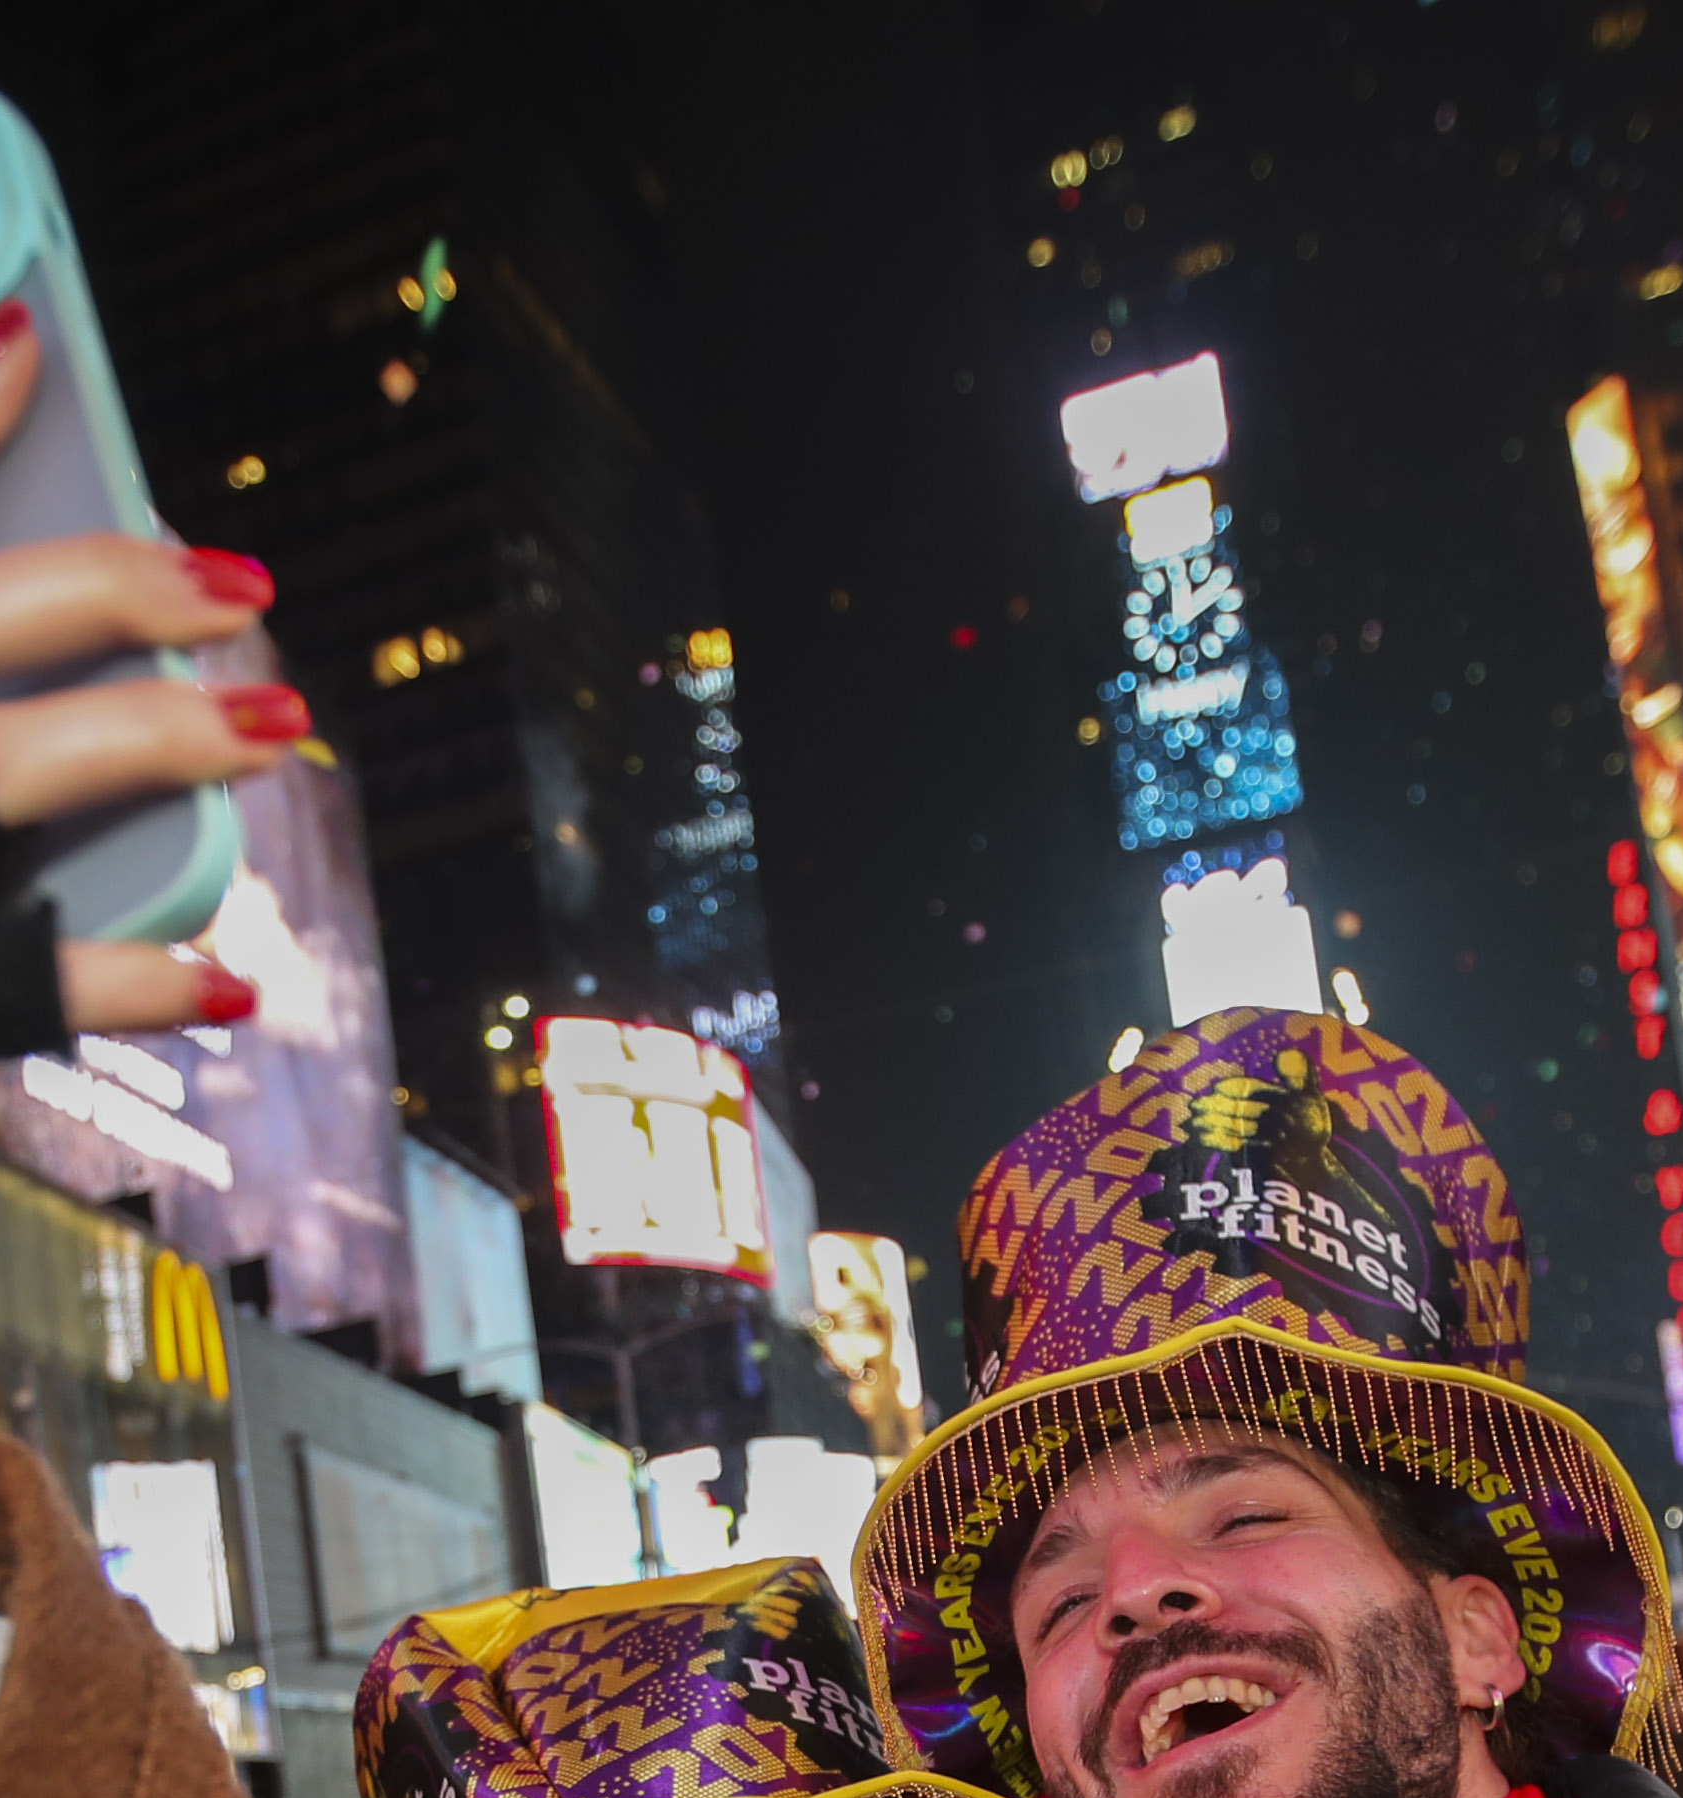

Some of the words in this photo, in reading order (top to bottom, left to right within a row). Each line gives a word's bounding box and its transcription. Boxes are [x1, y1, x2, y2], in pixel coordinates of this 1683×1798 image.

[1180, 1168, 1409, 1271] planet
[1218, 1203, 1442, 1341] fitness
[1485, 1502, 1560, 1581] EVE
[934, 1552, 991, 1696] YEARS
